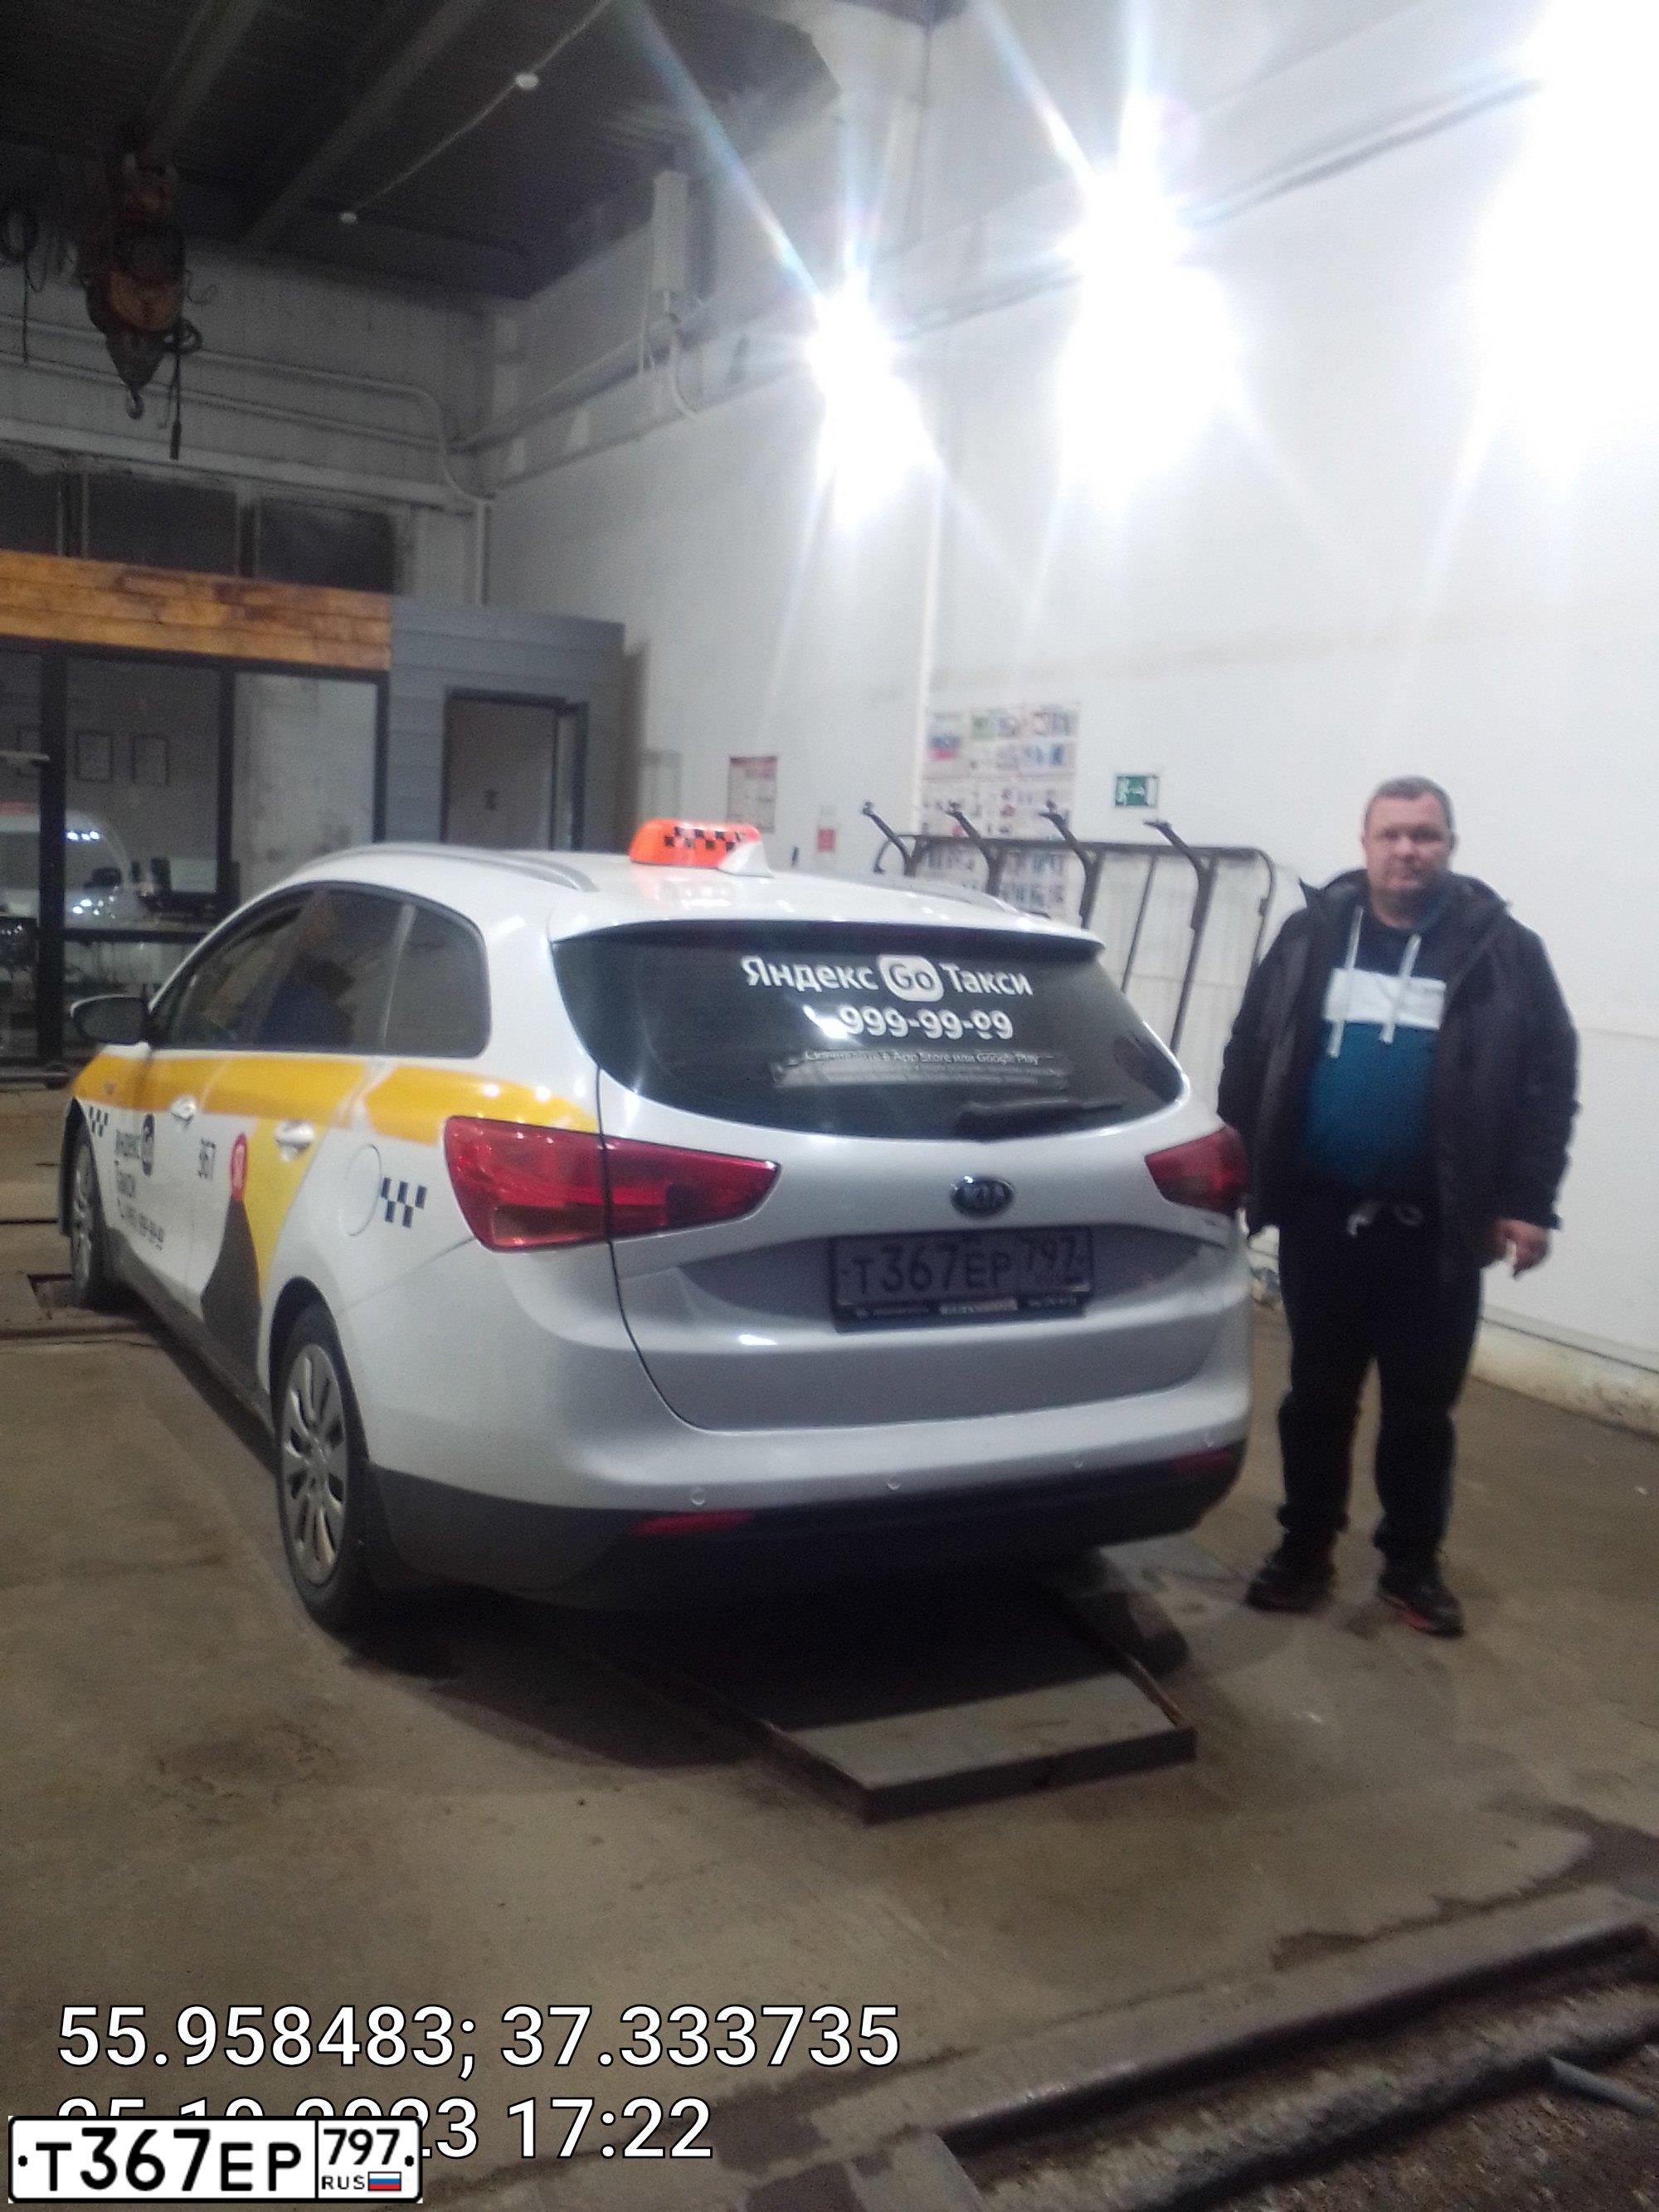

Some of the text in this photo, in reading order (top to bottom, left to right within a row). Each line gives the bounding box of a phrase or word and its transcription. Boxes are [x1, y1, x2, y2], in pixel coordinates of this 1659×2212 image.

[741, 955, 1034, 996] Яндекс Go Такси
[836, 1004, 1014, 1040] 999-99-99
